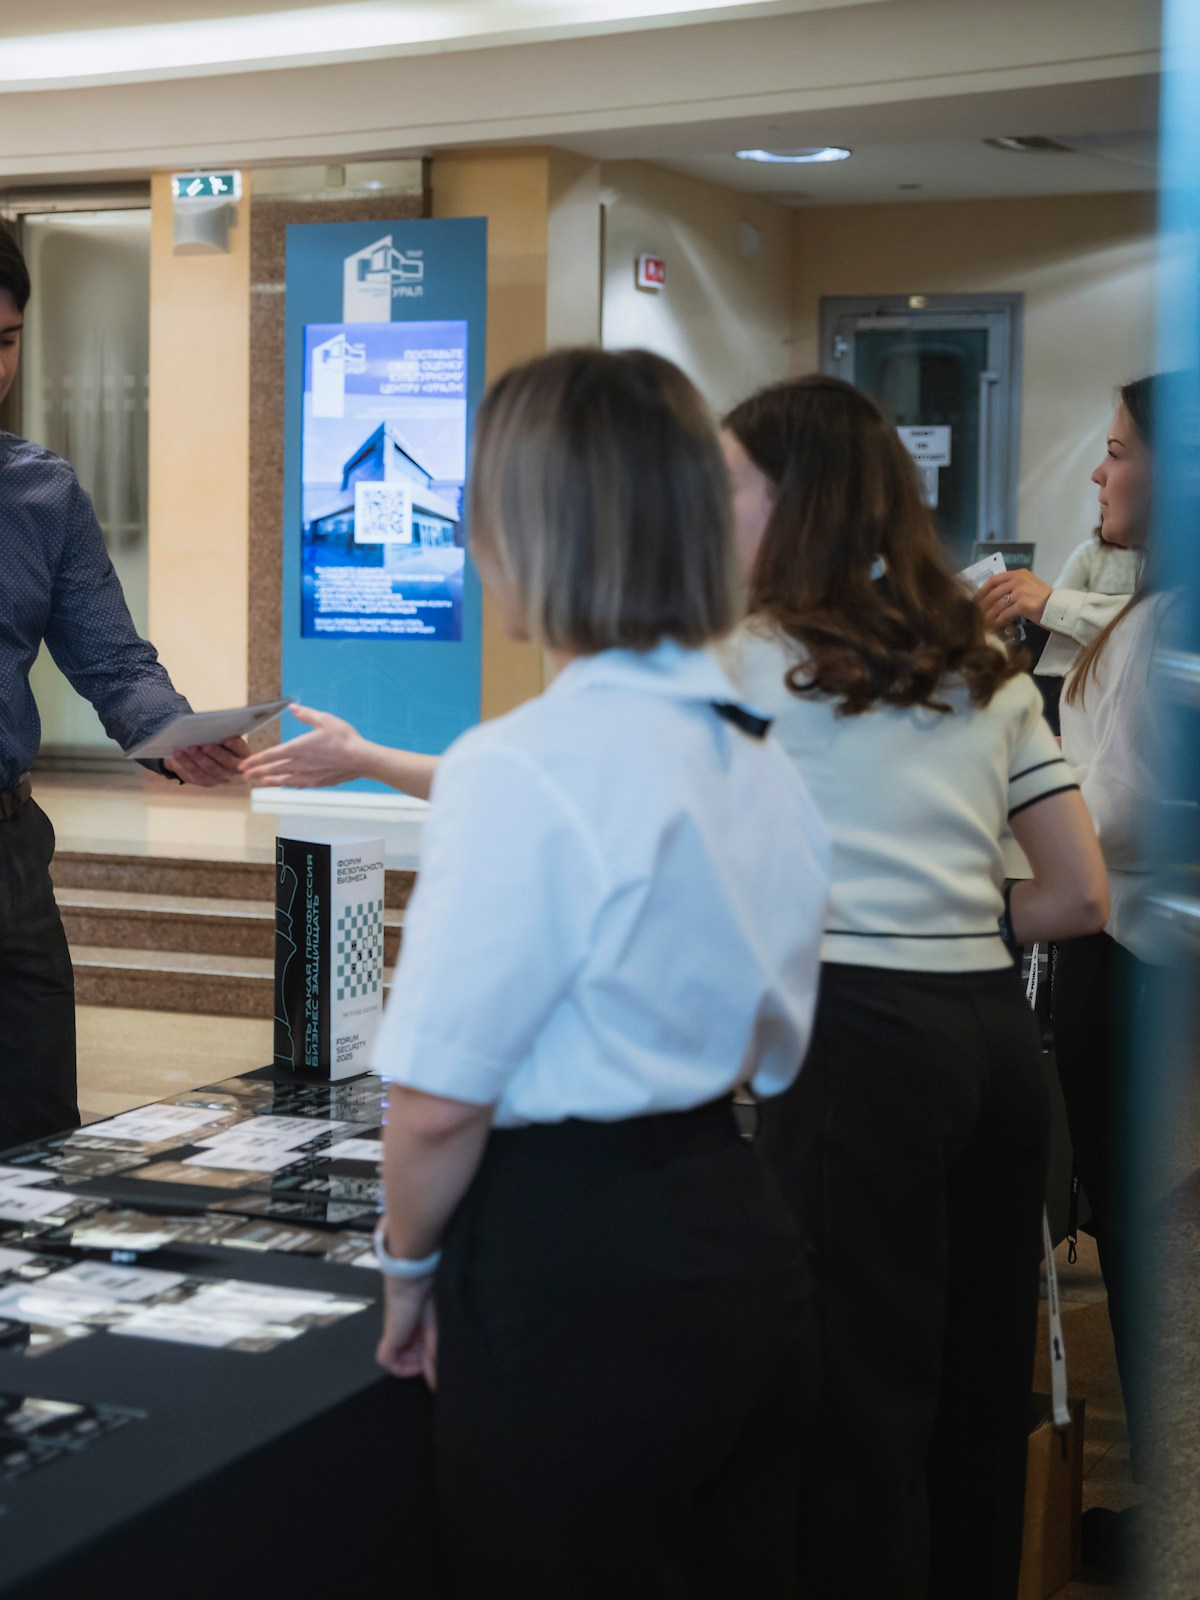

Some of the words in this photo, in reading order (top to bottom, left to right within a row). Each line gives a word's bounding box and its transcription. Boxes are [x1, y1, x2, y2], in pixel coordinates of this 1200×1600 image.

[337, 858, 362, 867] ФОРУМ
[337, 874, 367, 884] БИЗНЕСА
[312, 895, 320, 995] ЗАЩИЩАТЬ
[336, 1034, 359, 1045] FORUM
[336, 1040, 366, 1054] SECURITY
[336, 1052, 353, 1063] 2025
